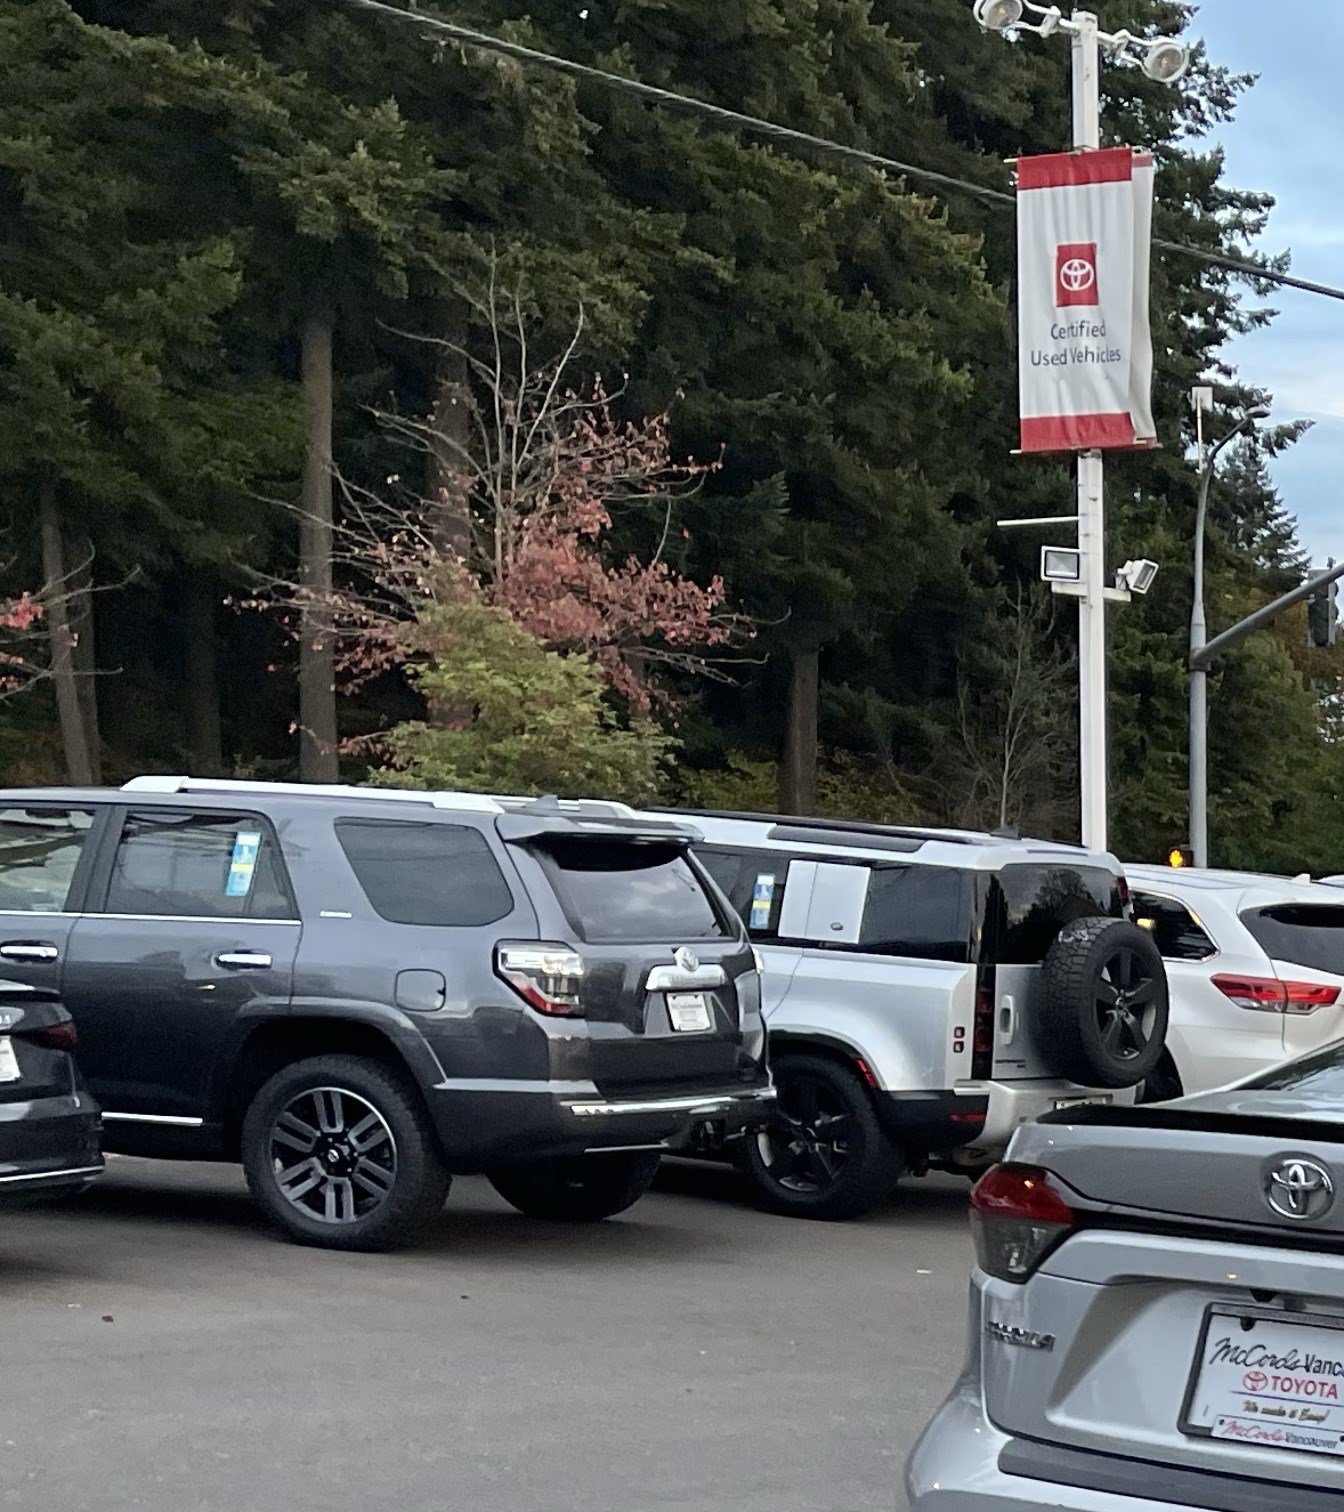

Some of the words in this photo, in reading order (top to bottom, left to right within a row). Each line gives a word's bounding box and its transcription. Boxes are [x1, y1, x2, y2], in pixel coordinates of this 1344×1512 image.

[1050, 321, 1107, 341] Certified
[1031, 349, 1068, 367] Used
[1070, 346, 1122, 364] Vehicles
[1271, 1375, 1339, 1399] TOYOTA
